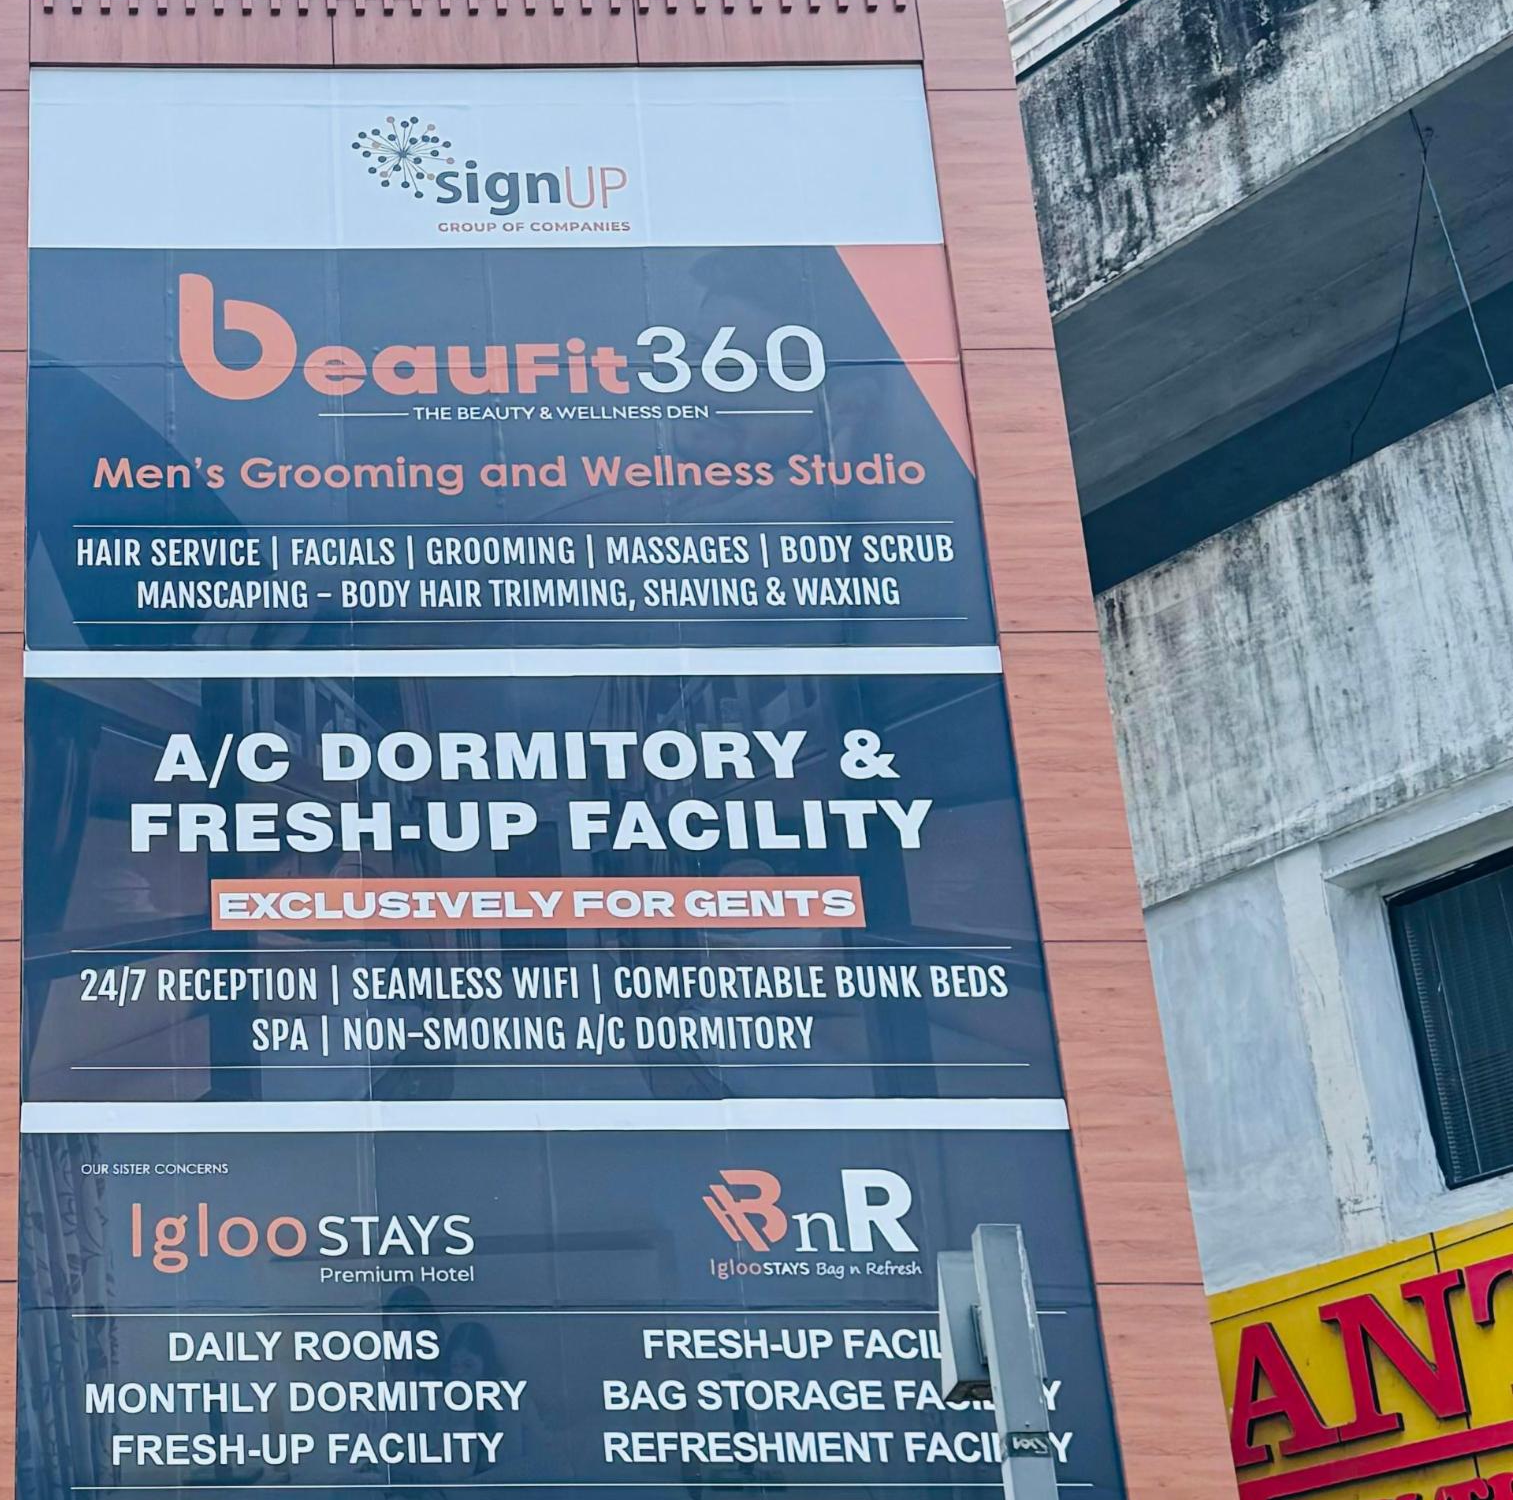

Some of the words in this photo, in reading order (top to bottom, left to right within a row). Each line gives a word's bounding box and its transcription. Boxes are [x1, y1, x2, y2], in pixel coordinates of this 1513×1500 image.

[437, 220, 497, 233] GROUP
[502, 220, 524, 233] OF
[529, 219, 632, 233] COMPANIES
[94, 454, 226, 490] Men's
[240, 455, 465, 497] Grooming
[481, 454, 568, 489] and
[581, 453, 775, 488] Wellness
[789, 451, 927, 487] Studio
[76, 537, 142, 567] HAIR
[151, 537, 261, 566] SERVICE
[290, 536, 396, 566] FACIALS
[425, 535, 576, 566] GROOMING
[605, 534, 750, 565] MASSAGES
[779, 534, 853, 564] BODY
[861, 533, 956, 563] SCRUB
[154, 731, 289, 789] A/C
[322, 730, 808, 782] DORMITORY
[840, 729, 901, 780] &
[130, 801, 539, 853] FRESH-UP
[570, 799, 934, 851] FACILITY
[217, 889, 564, 920] EXCLUSIVELY
[572, 889, 677, 919] FOR
[686, 888, 857, 919] GENTS
[79, 967, 146, 1005] 24/7
[156, 967, 319, 1002] RECEPTION
[351, 967, 504, 1001] SEAMLESS
[512, 966, 580, 1000] WIFI
[614, 965, 828, 1000] COMFORTABLE
[834, 965, 922, 999] BUNK
[930, 964, 1010, 999] BEDS
[81, 1163, 109, 1175] OUR
[112, 1163, 150, 1175] SISTER
[154, 1163, 229, 1175] CONCERNS
[320, 1266, 414, 1284] Premium
[421, 1266, 475, 1283] Hotel
[816, 1261, 845, 1279] Bag
[850, 1266, 861, 1276] n
[866, 1259, 922, 1276] Refresh
[643, 1328, 834, 1361] FRESH-UP
[843, 1328, 942, 1360] FACIL
[85, 1382, 277, 1415] MONTHLY
[289, 1380, 528, 1414] DORMITORY
[603, 1380, 686, 1412] BAG
[697, 1379, 886, 1412] STORAGE
[604, 1432, 894, 1464] REFRESHMENT
